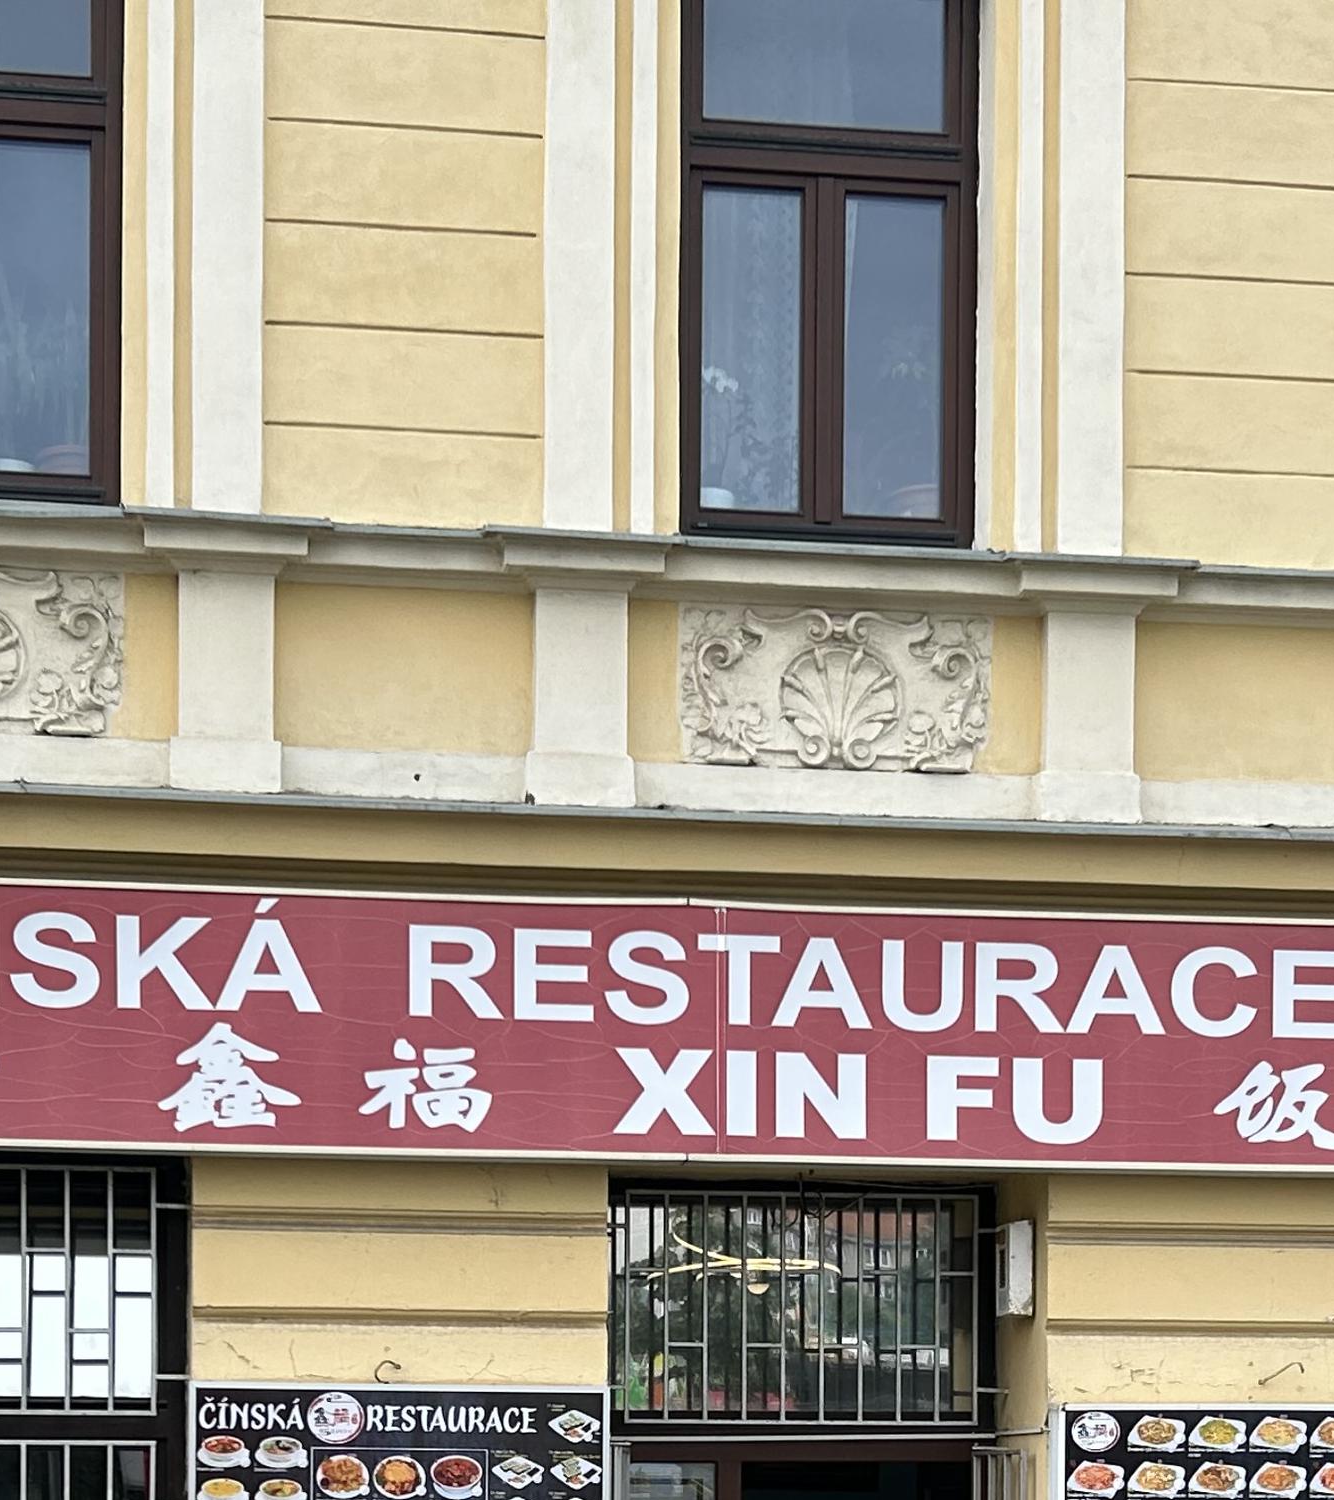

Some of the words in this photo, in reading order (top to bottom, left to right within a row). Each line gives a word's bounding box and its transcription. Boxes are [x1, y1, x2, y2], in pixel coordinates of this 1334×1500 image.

[613, 1047, 867, 1141] XIN
[926, 1054, 1103, 1145] FU
[199, 1397, 305, 1431] ČÍNSKÁ
[366, 1404, 538, 1434] RESTAURACE
